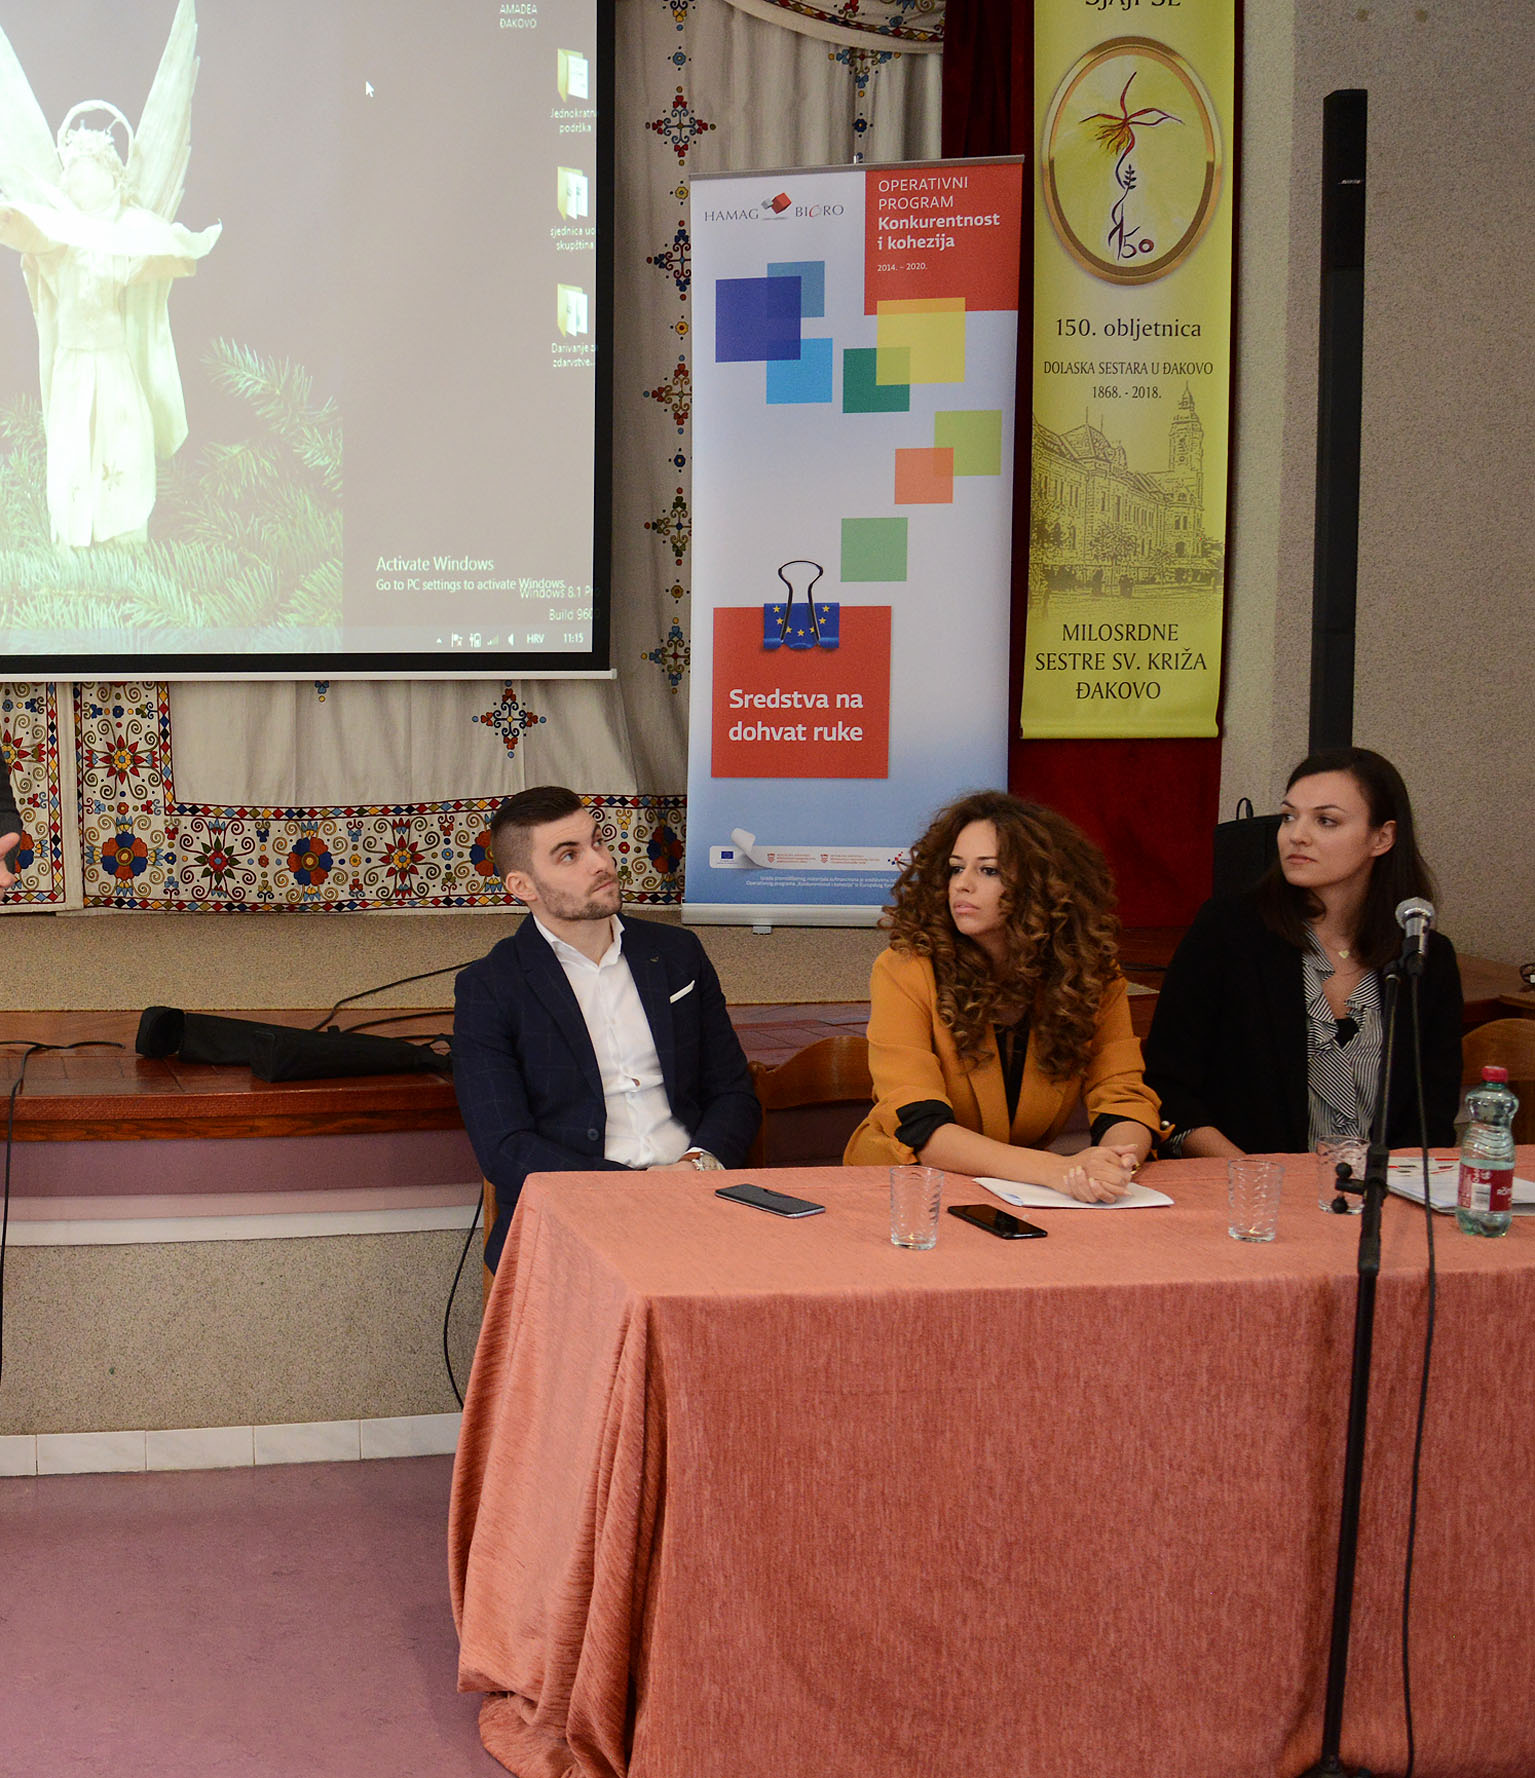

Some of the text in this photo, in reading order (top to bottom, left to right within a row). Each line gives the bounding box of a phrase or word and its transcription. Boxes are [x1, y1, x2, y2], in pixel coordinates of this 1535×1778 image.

[499, 4, 537, 15] AMADEA
[499, 18, 537, 29] ĐAKOVO
[878, 176, 969, 193] OPERATIVNI
[878, 195, 954, 212] PROGRAM
[704, 208, 759, 223] HAMAG
[878, 212, 1001, 231] Konkurentnost
[877, 233, 955, 252] i kohezija
[877, 264, 898, 272] 2014.
[906, 262, 928, 271] 2020.
[1056, 318, 1202, 342] 150. obljetnica
[1044, 360, 1214, 376] DOLASKA SESTARA U ĐAKOVO
[1092, 385, 1121, 399] 1868.
[1132, 385, 1162, 400] 2018.
[376, 555, 495, 572] Activate Windows
[376, 579, 390, 592] Go
[392, 580, 404, 591] to
[407, 579, 421, 591] PC
[422, 578, 461, 593] settings
[463, 579, 475, 591] to
[477, 578, 516, 591] activate
[567, 585, 582, 599] 8.1
[527, 633, 584, 644] HRV 11:15
[1062, 623, 1179, 642] MILOSRDNE
[1035, 648, 1207, 671] SESTRE SV. KRIŽA
[728, 687, 864, 710] Sredstva na
[1076, 681, 1161, 700] ĐAKOVO
[728, 720, 864, 742] dohvat ruke
